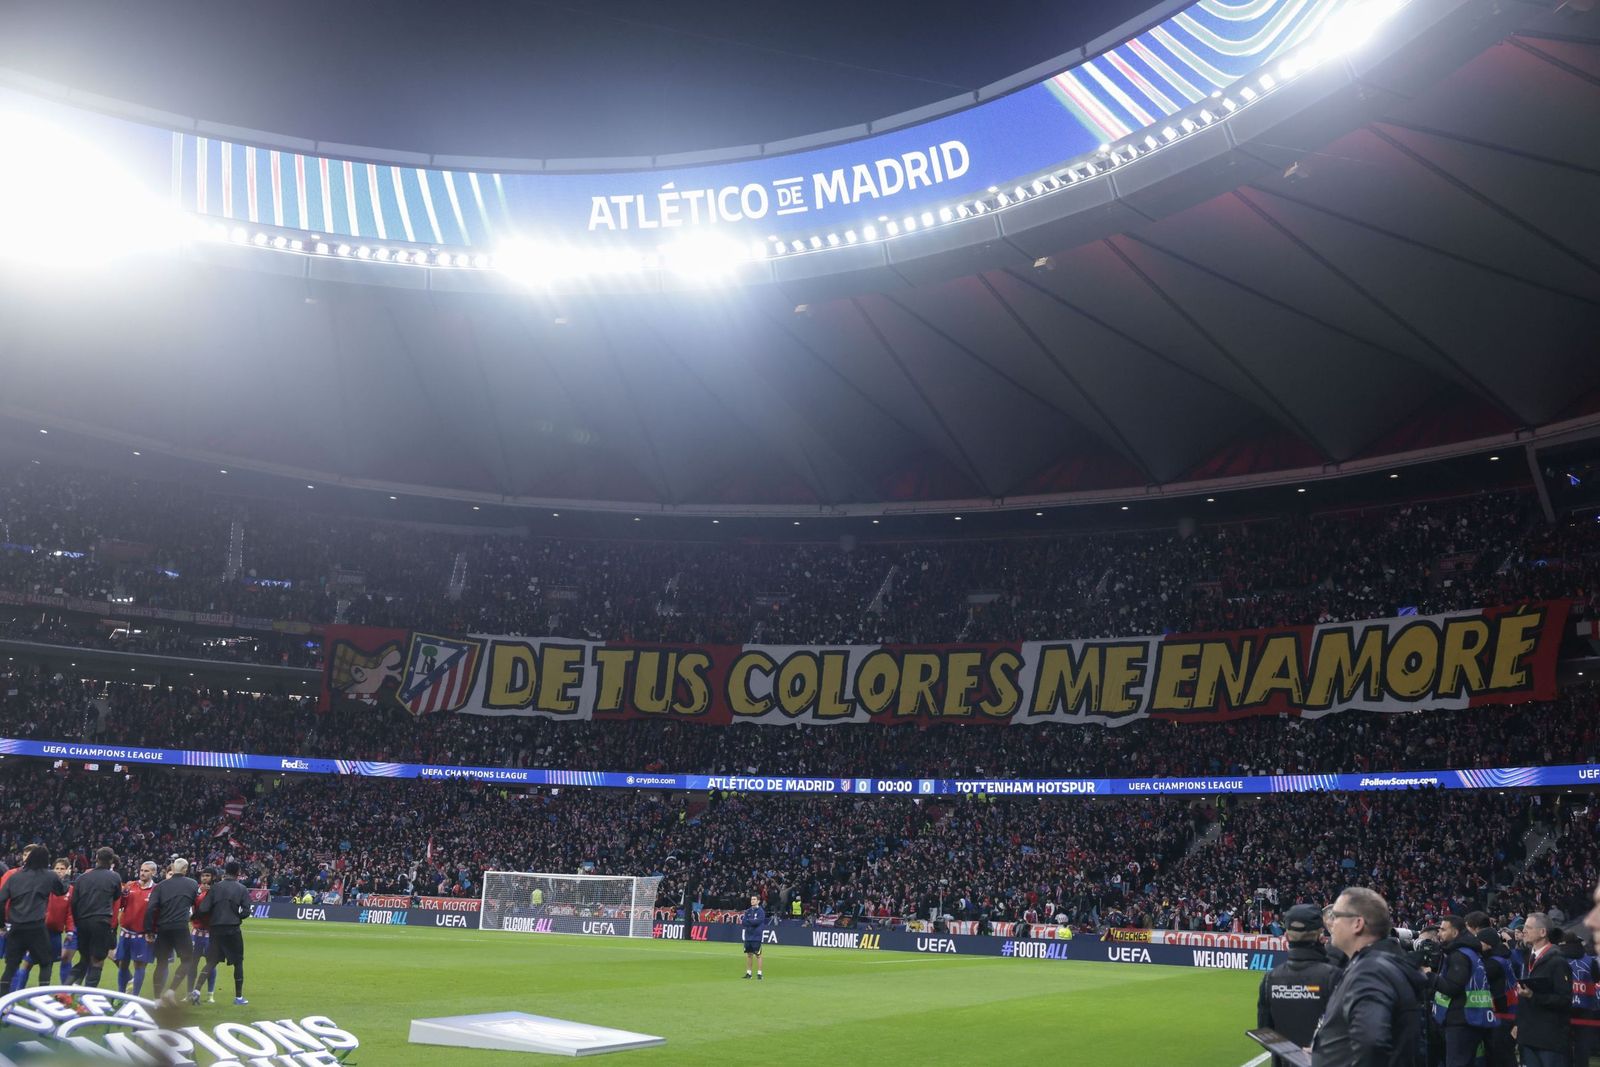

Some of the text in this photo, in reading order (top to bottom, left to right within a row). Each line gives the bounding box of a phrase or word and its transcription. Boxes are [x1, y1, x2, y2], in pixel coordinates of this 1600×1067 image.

[587, 140, 970, 231] ATLÉTICO DE MADRID
[486, 604, 1541, 718] DE TUS COLORES ME ENAMORÉ
[43, 745, 164, 760] UEFA CHAMPIONS LEAGUE
[422, 768, 528, 780] UEFA CHAMPIONS LEAGUE
[707, 776, 835, 791] ATLÉTICO DE MADRID
[858, 780, 931, 793] 0 00:00 0
[955, 781, 1095, 793] TOTTENHAM HOTSPUR
[1128, 780, 1243, 790] UEFA CHAMPIONS LEAGUE
[253, 904, 271, 918] ALL
[419, 899, 440, 910] ARA
[442, 901, 478, 912] MORIR
[296, 907, 327, 921] UEFA
[359, 909, 408, 926] #FOOTBALL
[435, 914, 468, 928] UEFA
[535, 918, 553, 932] ALL
[582, 921, 616, 935] UEFA
[812, 931, 881, 950] WELCOME ALL
[917, 937, 957, 953] UEFA
[1001, 940, 1068, 960] #FOOTBALL
[1108, 946, 1152, 963] UEFA
[1193, 950, 1274, 971] WELCOME ALL
[2, 994, 160, 1036] UEFA
